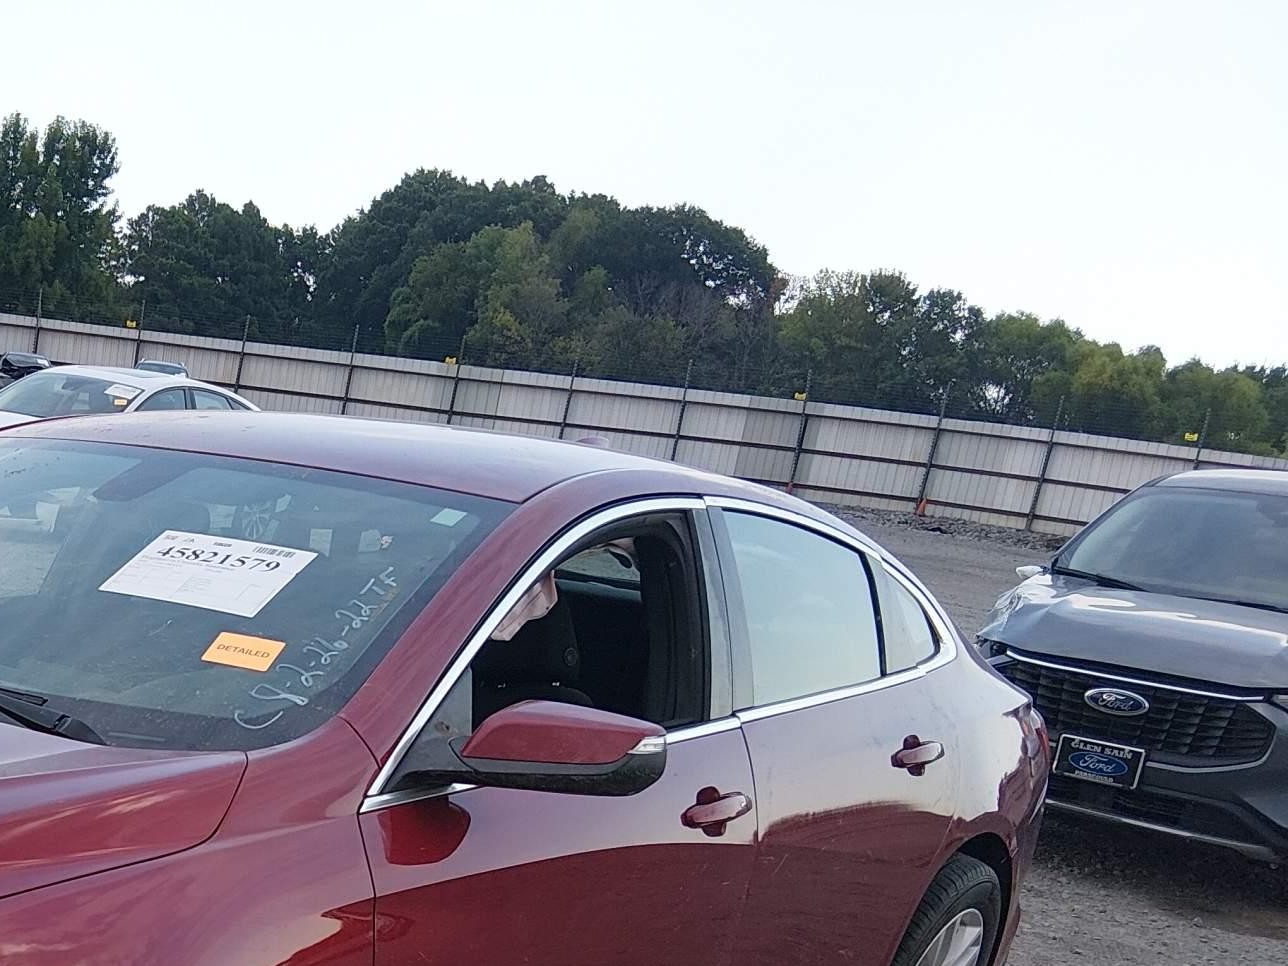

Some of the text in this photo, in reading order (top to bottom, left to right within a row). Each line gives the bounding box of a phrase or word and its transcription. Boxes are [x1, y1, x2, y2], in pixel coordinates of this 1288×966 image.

[155, 545, 282, 573] 45821579
[216, 643, 271, 660] DETAILED
[1070, 740, 1102, 753] GLEN
[1079, 754, 1116, 772] Ford
